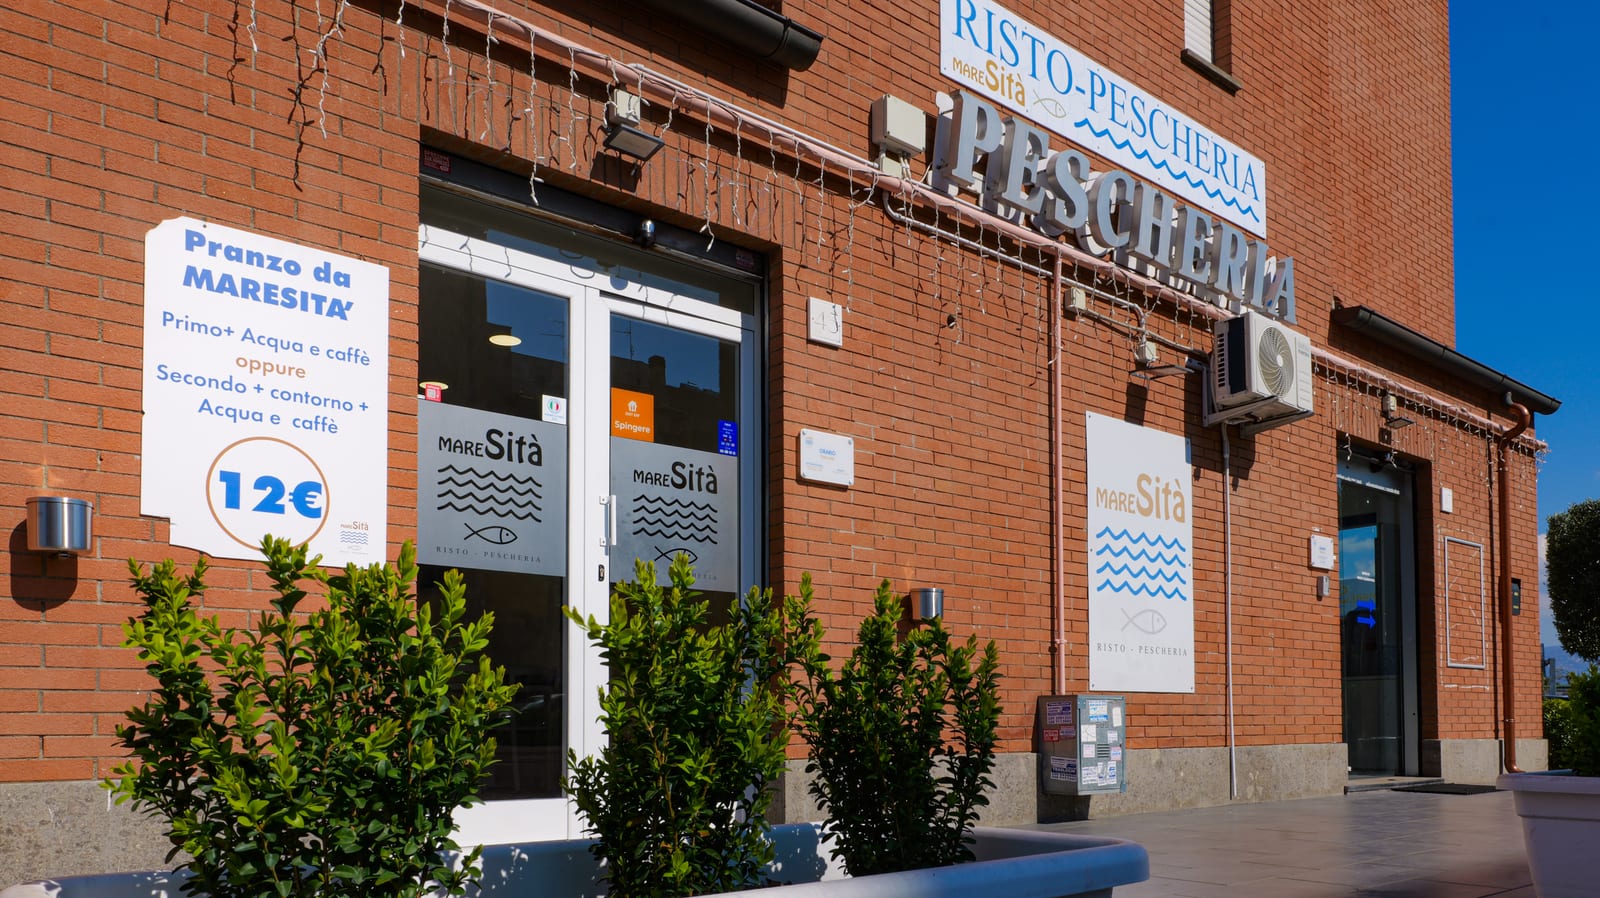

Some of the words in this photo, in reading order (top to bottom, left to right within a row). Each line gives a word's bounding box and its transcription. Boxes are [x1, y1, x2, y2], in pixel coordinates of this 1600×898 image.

[952, 0, 1260, 202] RISTO-PESCHERIA
[950, 88, 1298, 326] PESCHERIA
[184, 229, 302, 277] Pranzo
[313, 261, 351, 288] da
[240, 327, 304, 352] Acqua
[309, 344, 321, 356] e
[325, 346, 371, 366] caffè
[235, 356, 306, 379] oppure
[156, 363, 247, 394] Secondo
[253, 383, 264, 395] +
[270, 388, 354, 412] contorno
[359, 401, 369, 413] +
[197, 398, 264, 423] Acqua
[269, 413, 281, 425] e
[291, 415, 338, 434] caffè
[614, 420, 651, 433] Spingere
[219, 470, 322, 519] 12€
[436, 546, 469, 556] RISTO
[483, 551, 542, 563] PESCHERIA
[1097, 642, 1126, 653] RISTO
[1138, 645, 1188, 657] PESCHERIA
